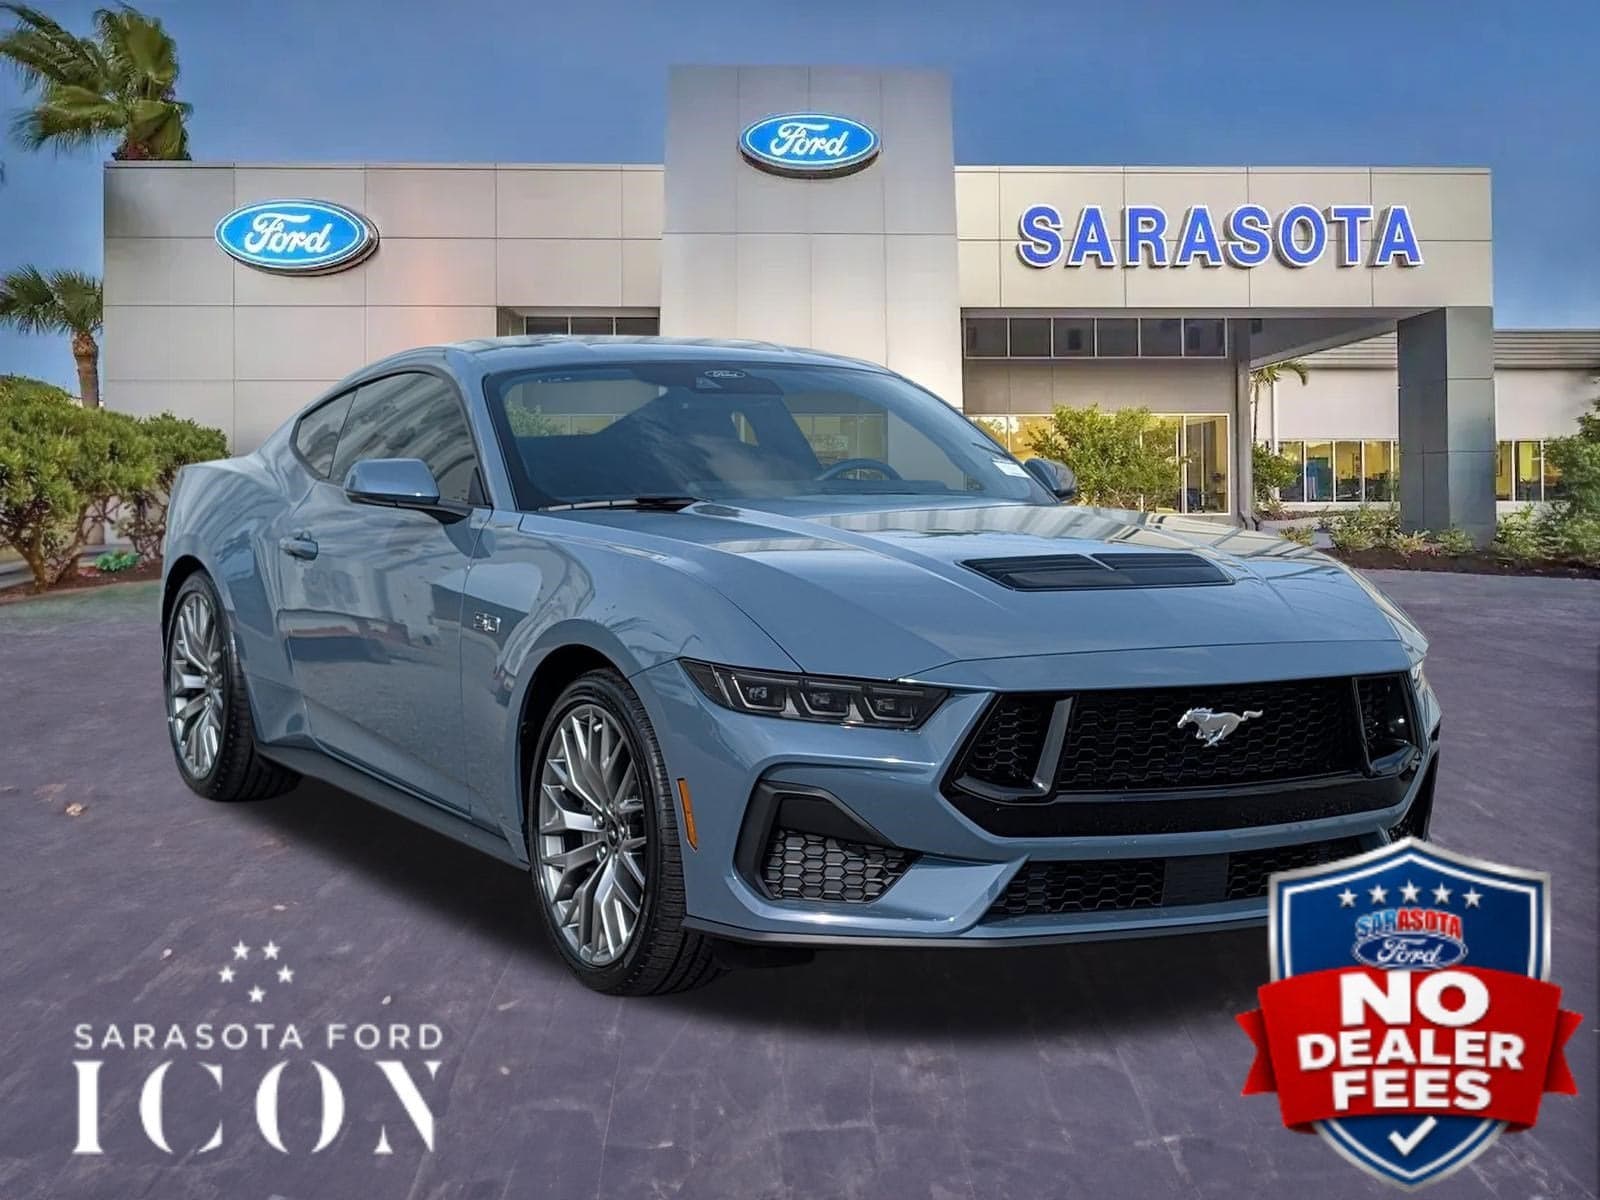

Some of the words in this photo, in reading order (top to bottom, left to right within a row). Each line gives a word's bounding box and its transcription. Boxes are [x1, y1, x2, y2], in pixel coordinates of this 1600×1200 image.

[769, 122, 849, 157] Ford
[244, 212, 333, 254] Ford
[1017, 204, 1424, 267] SARASOTA
